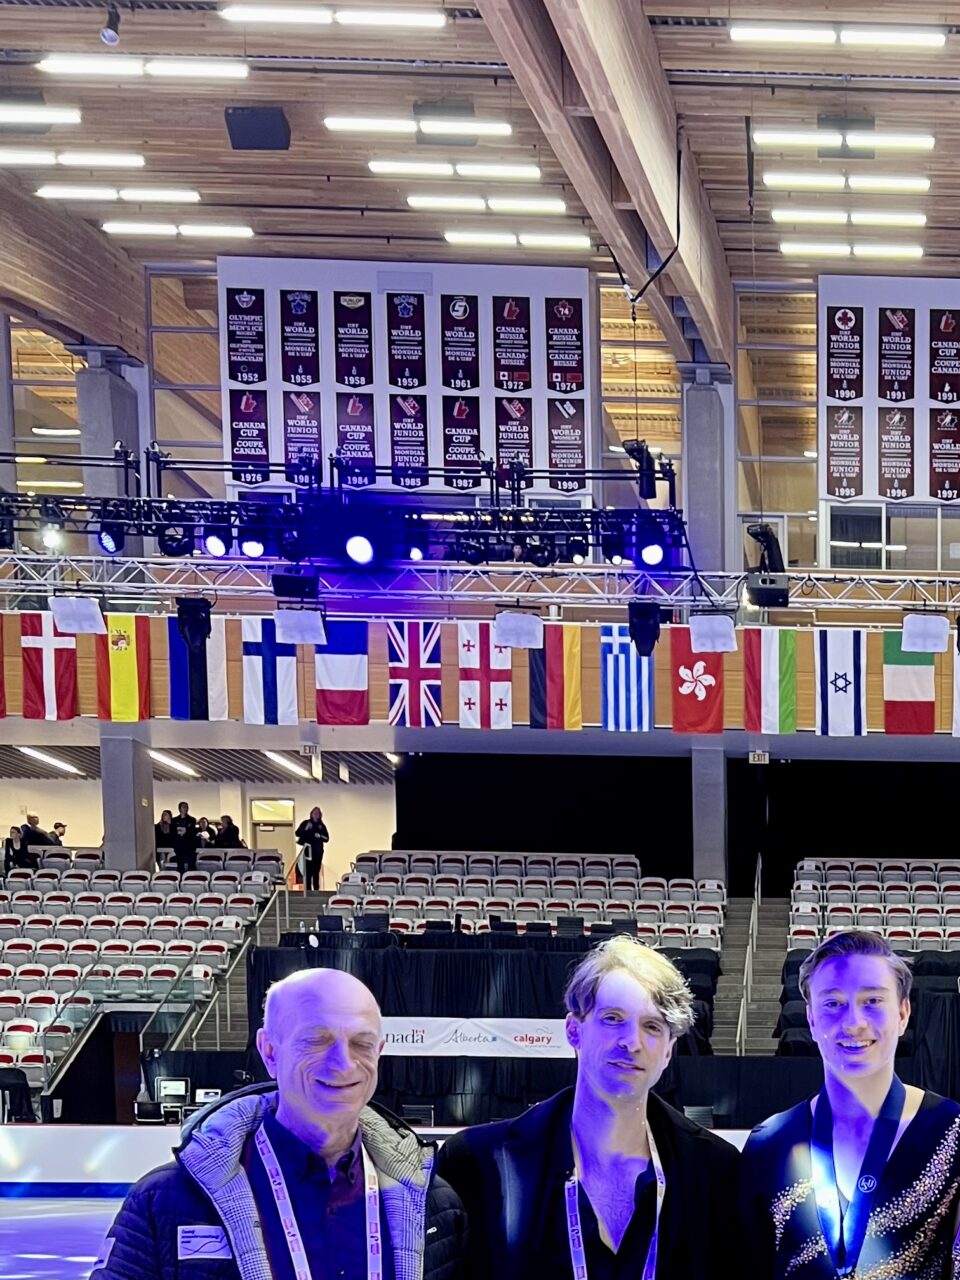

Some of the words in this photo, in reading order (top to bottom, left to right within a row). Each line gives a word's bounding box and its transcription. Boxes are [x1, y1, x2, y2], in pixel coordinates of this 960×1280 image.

[237, 373, 258, 381] 1952
[291, 375, 312, 383] 1955
[344, 377, 365, 385] 1958
[398, 378, 418, 386] 1959
[451, 380, 471, 388] 1961
[503, 381, 524, 389] 1972
[556, 383, 576, 391] 1974
[835, 390, 855, 398] 1990
[347, 477, 368, 485] 1984
[400, 478, 421, 486] 1985
[453, 479, 473, 488] 1987
[558, 481, 578, 489] 1990
[835, 488, 855, 496] 1995
[887, 489, 906, 497] 1996
[938, 490, 957, 498] 1997
[753, 754, 766, 762] EXIT
[386, 1030, 425, 1043] nada
[444, 1029, 491, 1043] Alberta
[514, 1034, 552, 1044] calgary
[861, 1179, 874, 1190] ISU
